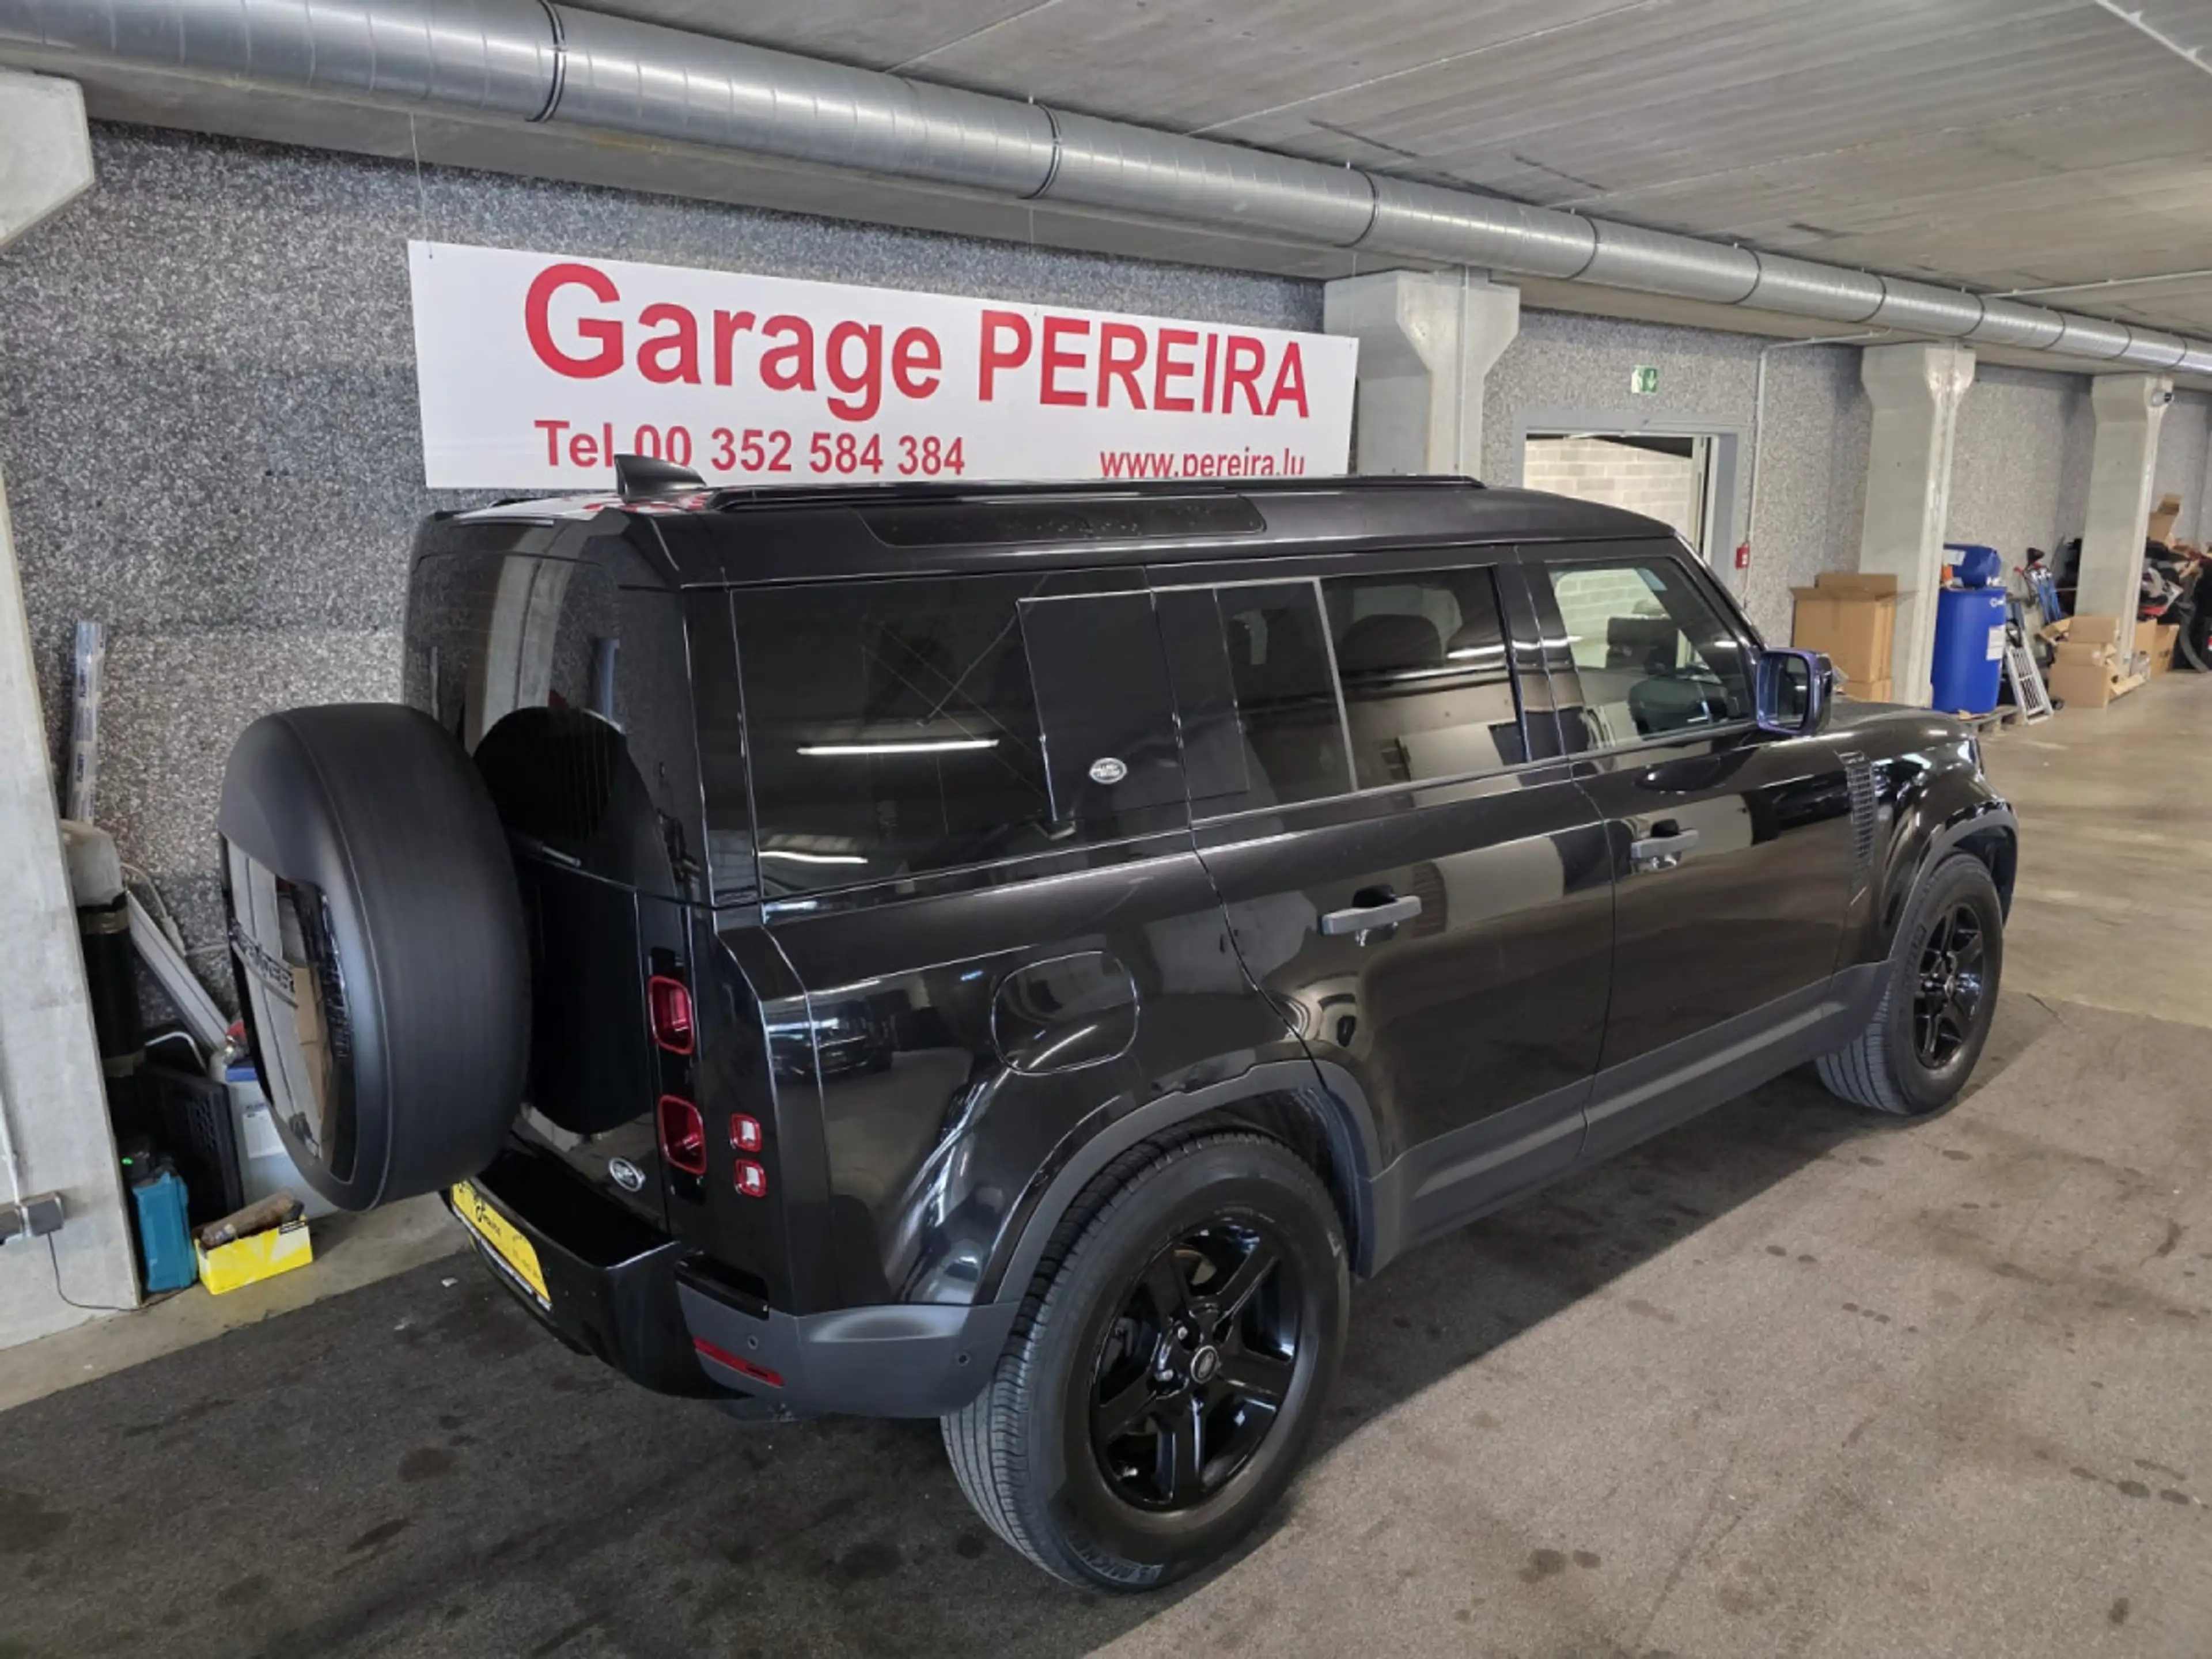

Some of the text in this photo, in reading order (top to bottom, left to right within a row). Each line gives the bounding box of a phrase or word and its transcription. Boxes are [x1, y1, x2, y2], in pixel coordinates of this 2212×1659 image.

[524, 263, 1310, 423] Garage PEREIRA
[634, 424, 693, 468] 00
[711, 427, 792, 474] 352
[810, 431, 884, 475] 584
[898, 435, 965, 476] 384
[1099, 445, 1305, 478] www.pereira.lu
